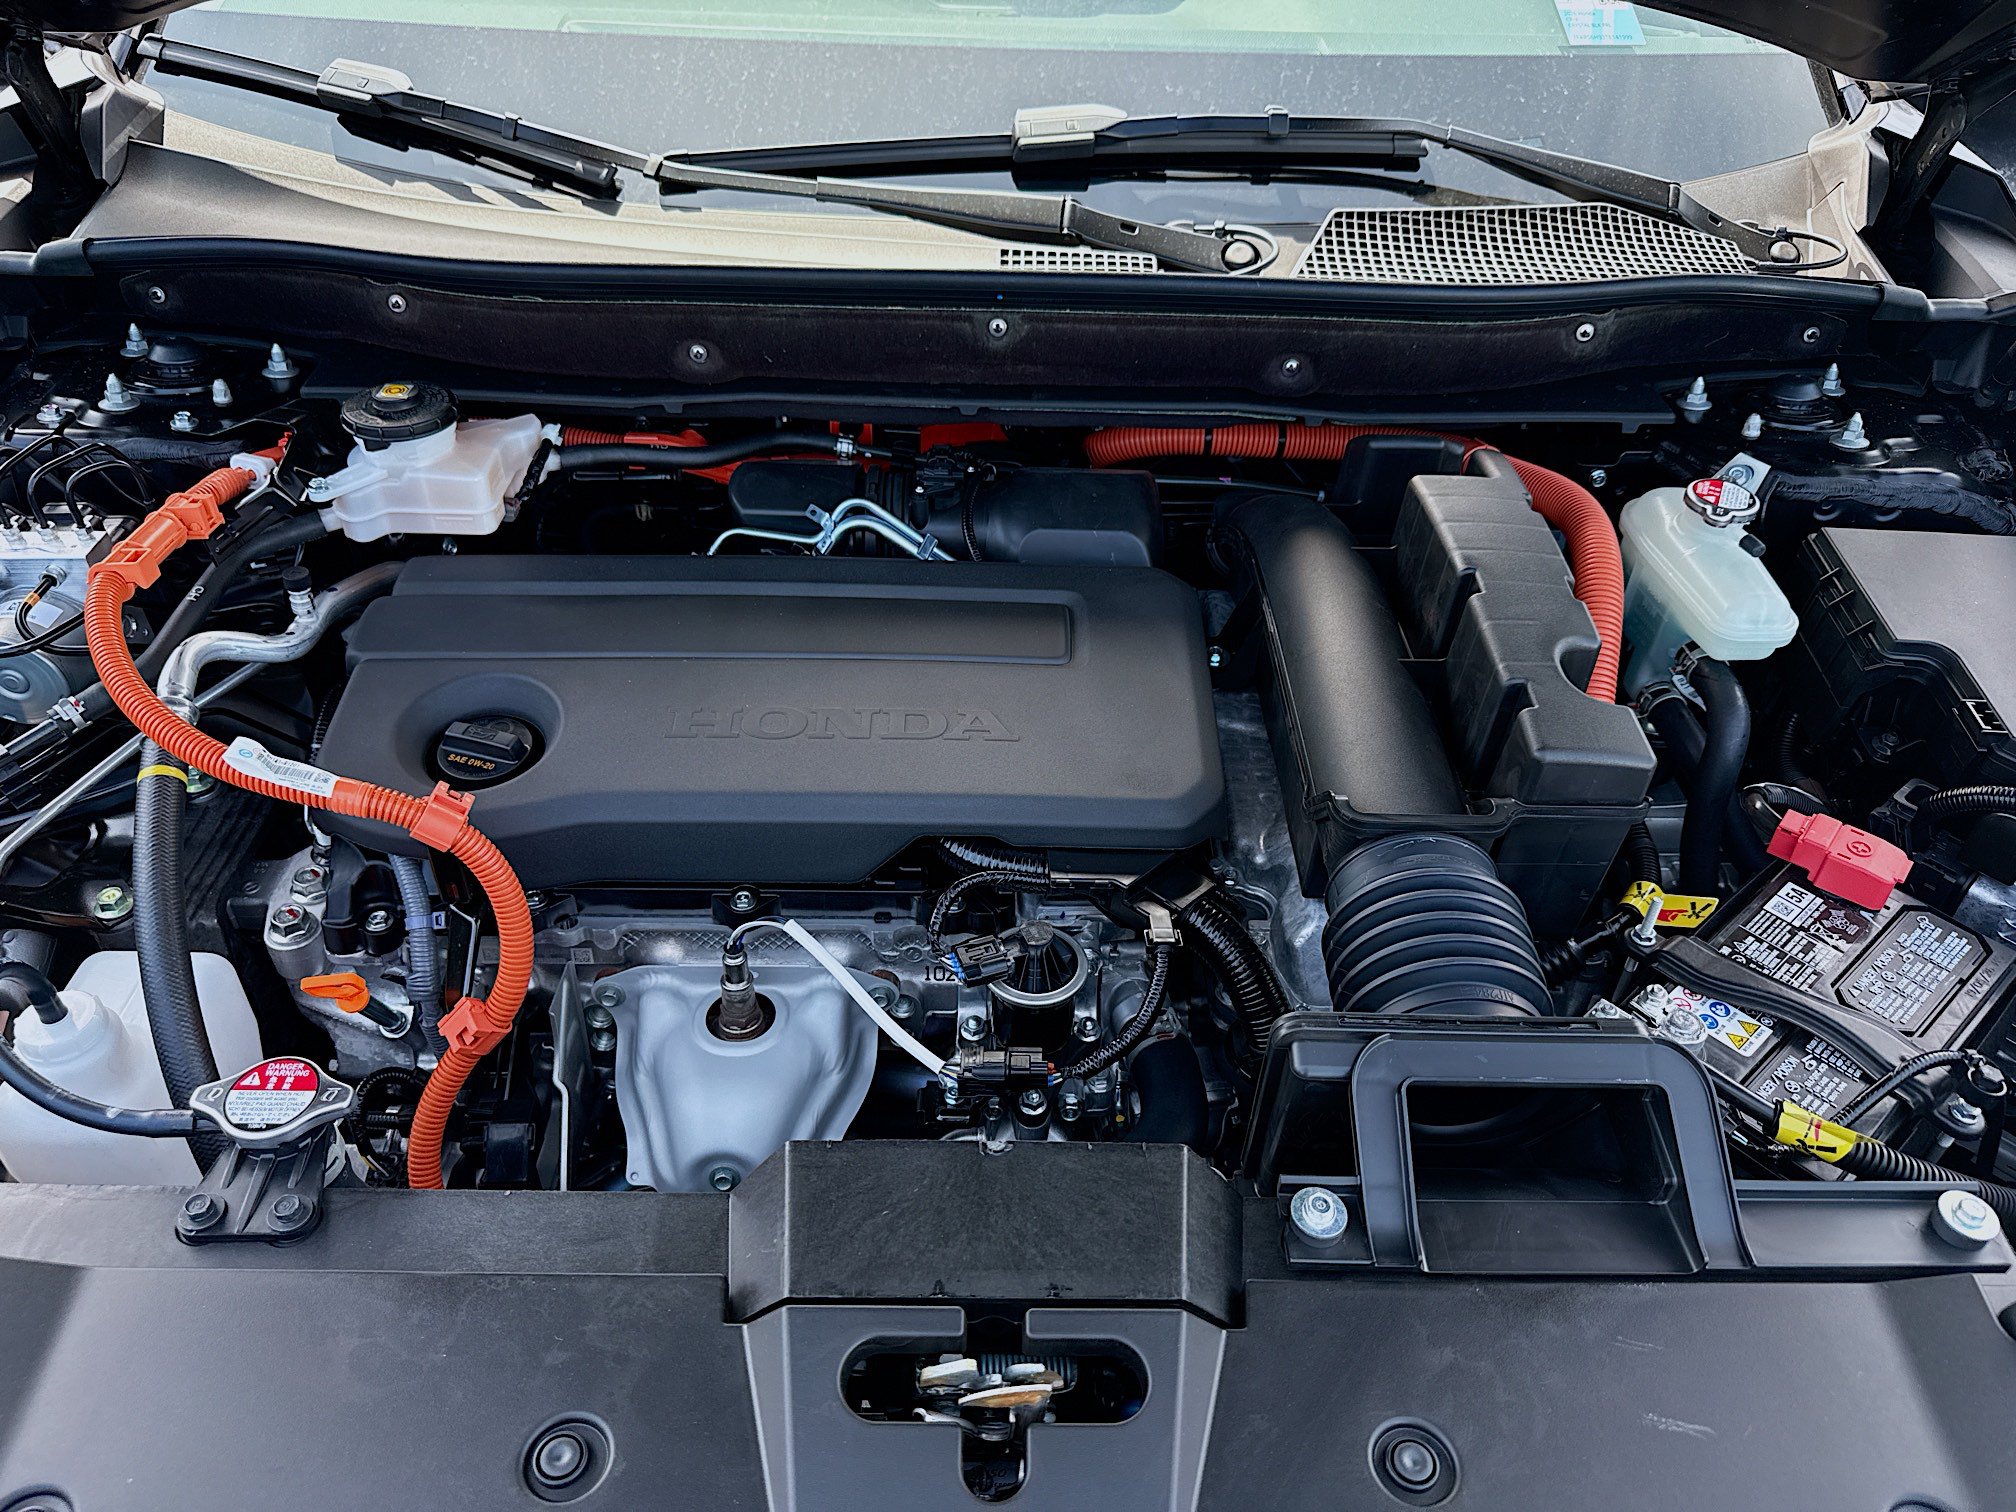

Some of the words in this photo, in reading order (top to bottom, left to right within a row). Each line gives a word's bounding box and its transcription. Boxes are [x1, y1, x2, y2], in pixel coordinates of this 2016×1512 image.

[663, 705, 1021, 743] HONDA
[447, 753, 469, 764] SAE
[467, 758, 496, 770] 0W-20
[1785, 888, 1809, 903] 5A
[265, 1069, 310, 1077] WARNUNG
[267, 1062, 305, 1071] DANGER
